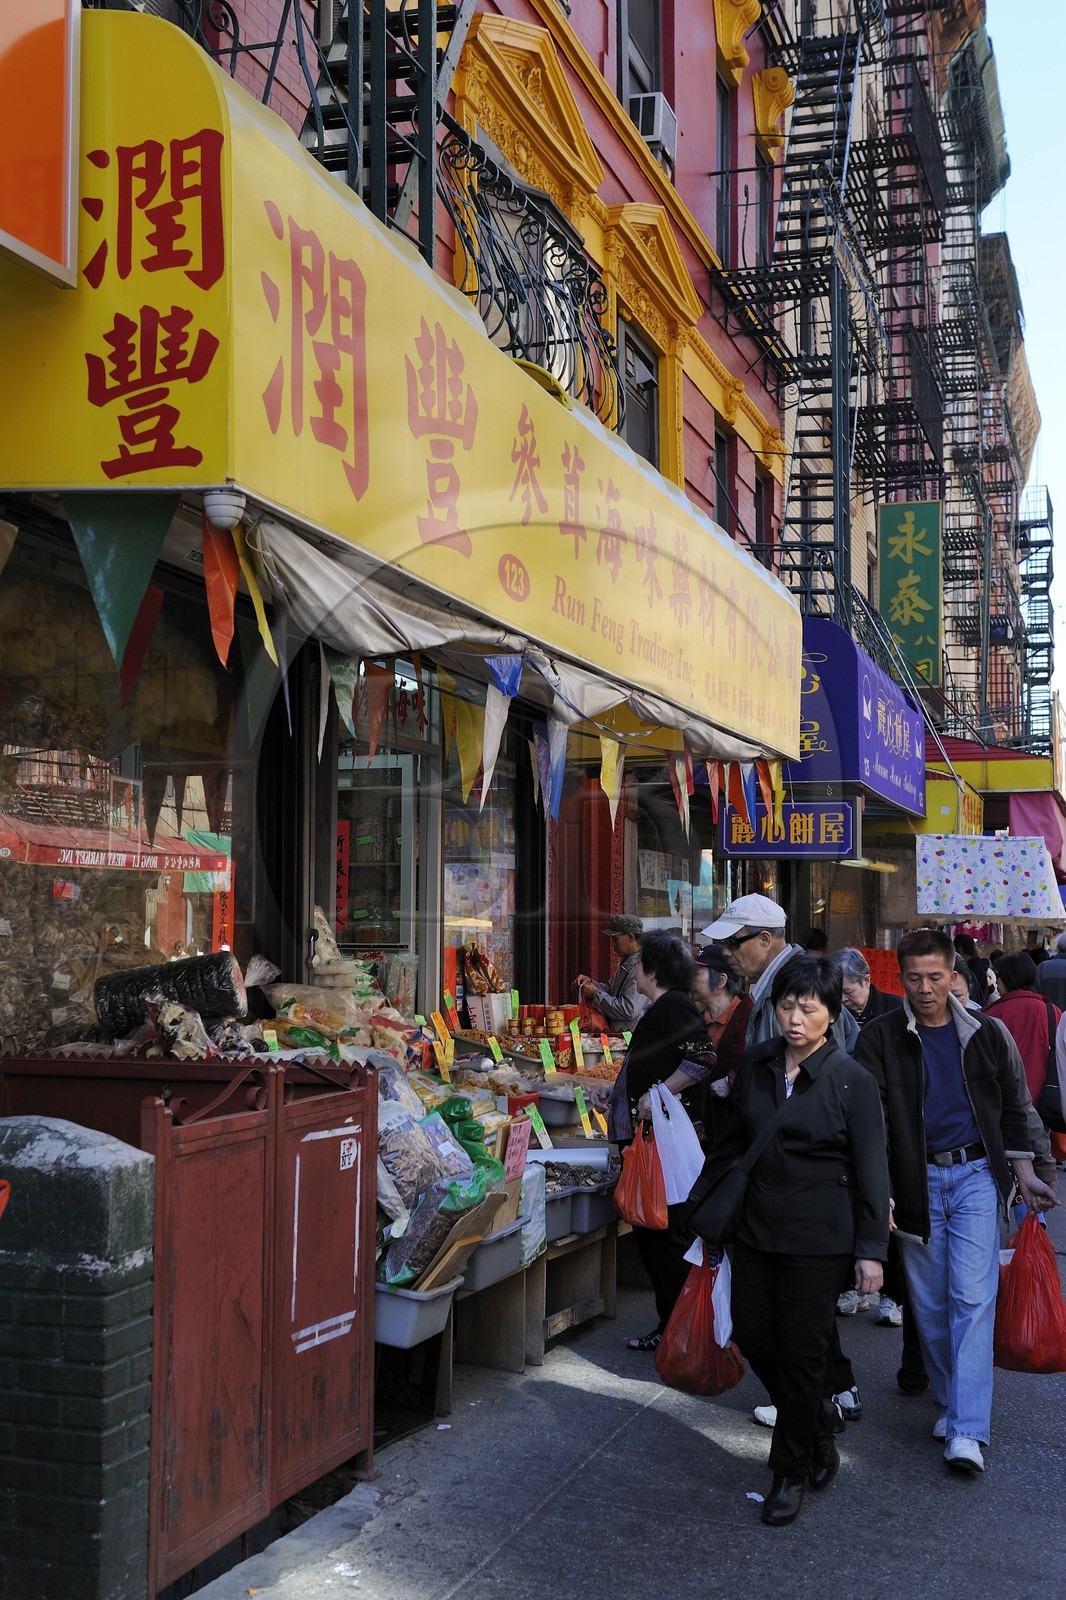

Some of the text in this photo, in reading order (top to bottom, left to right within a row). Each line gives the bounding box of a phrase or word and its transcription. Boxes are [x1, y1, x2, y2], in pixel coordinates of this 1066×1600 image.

[504, 559, 525, 596] 123
[886, 510, 935, 626] 永泰
[552, 574, 696, 686] Run Feng Trading Inc.
[730, 812, 845, 845] 麗心餅屋
[341, 1153, 353, 1167] NY
